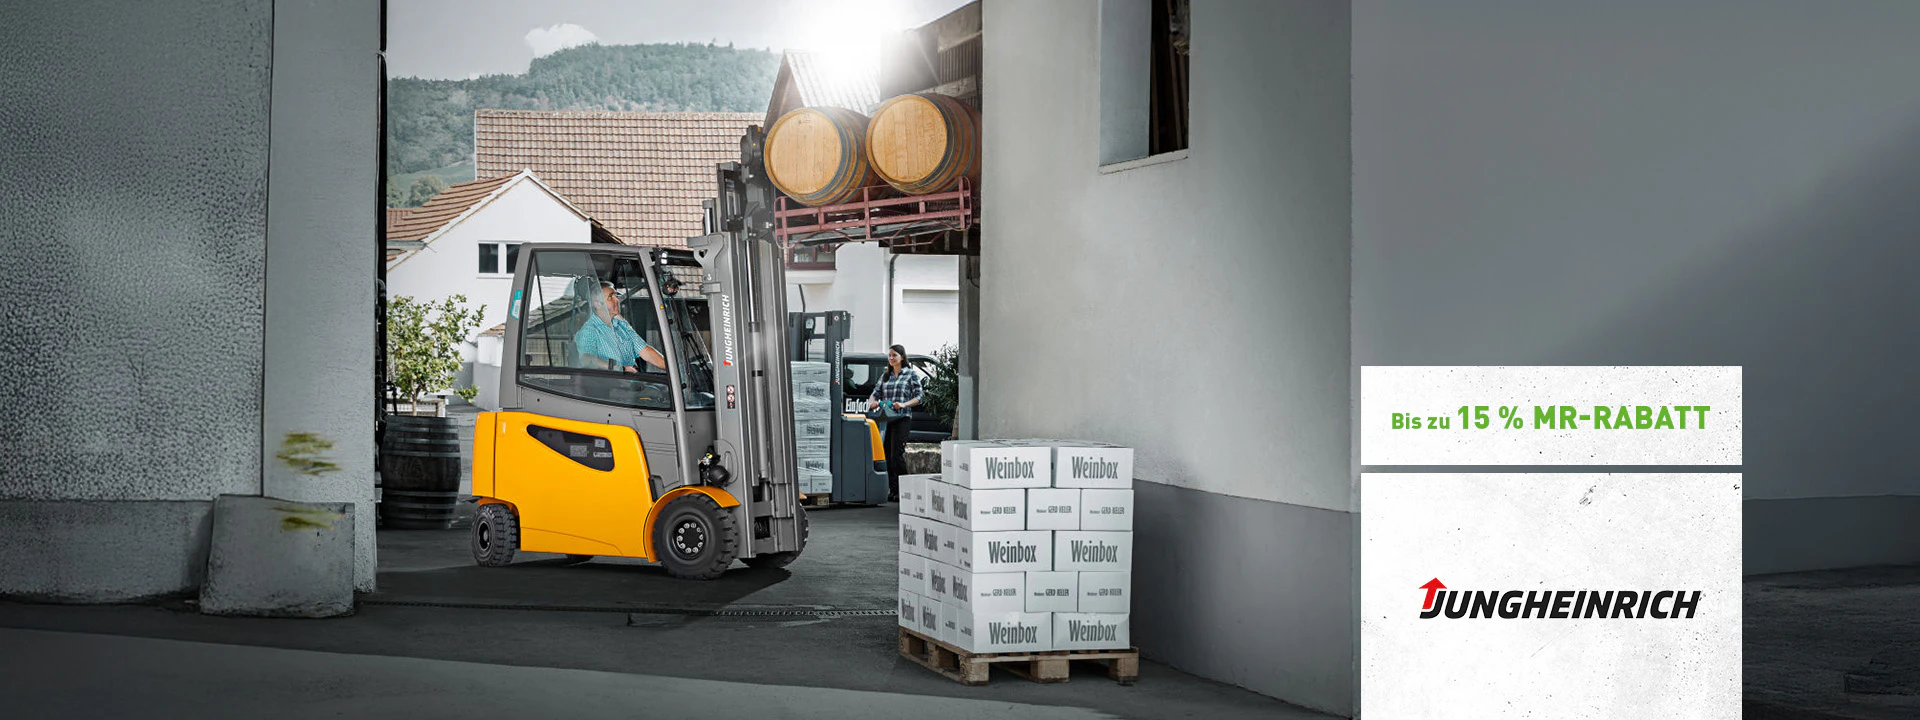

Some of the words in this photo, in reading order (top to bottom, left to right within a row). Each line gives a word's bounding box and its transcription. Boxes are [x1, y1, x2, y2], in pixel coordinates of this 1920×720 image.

[722, 295, 734, 366] JUNGHEINRICH
[985, 456, 1034, 479] Weinbox
[1072, 456, 1118, 479] Weinbox
[988, 541, 1037, 564] Weinbox
[1071, 540, 1118, 563] Weinbox
[989, 622, 1038, 645] Weinbox
[1069, 620, 1117, 642] Weinbox
